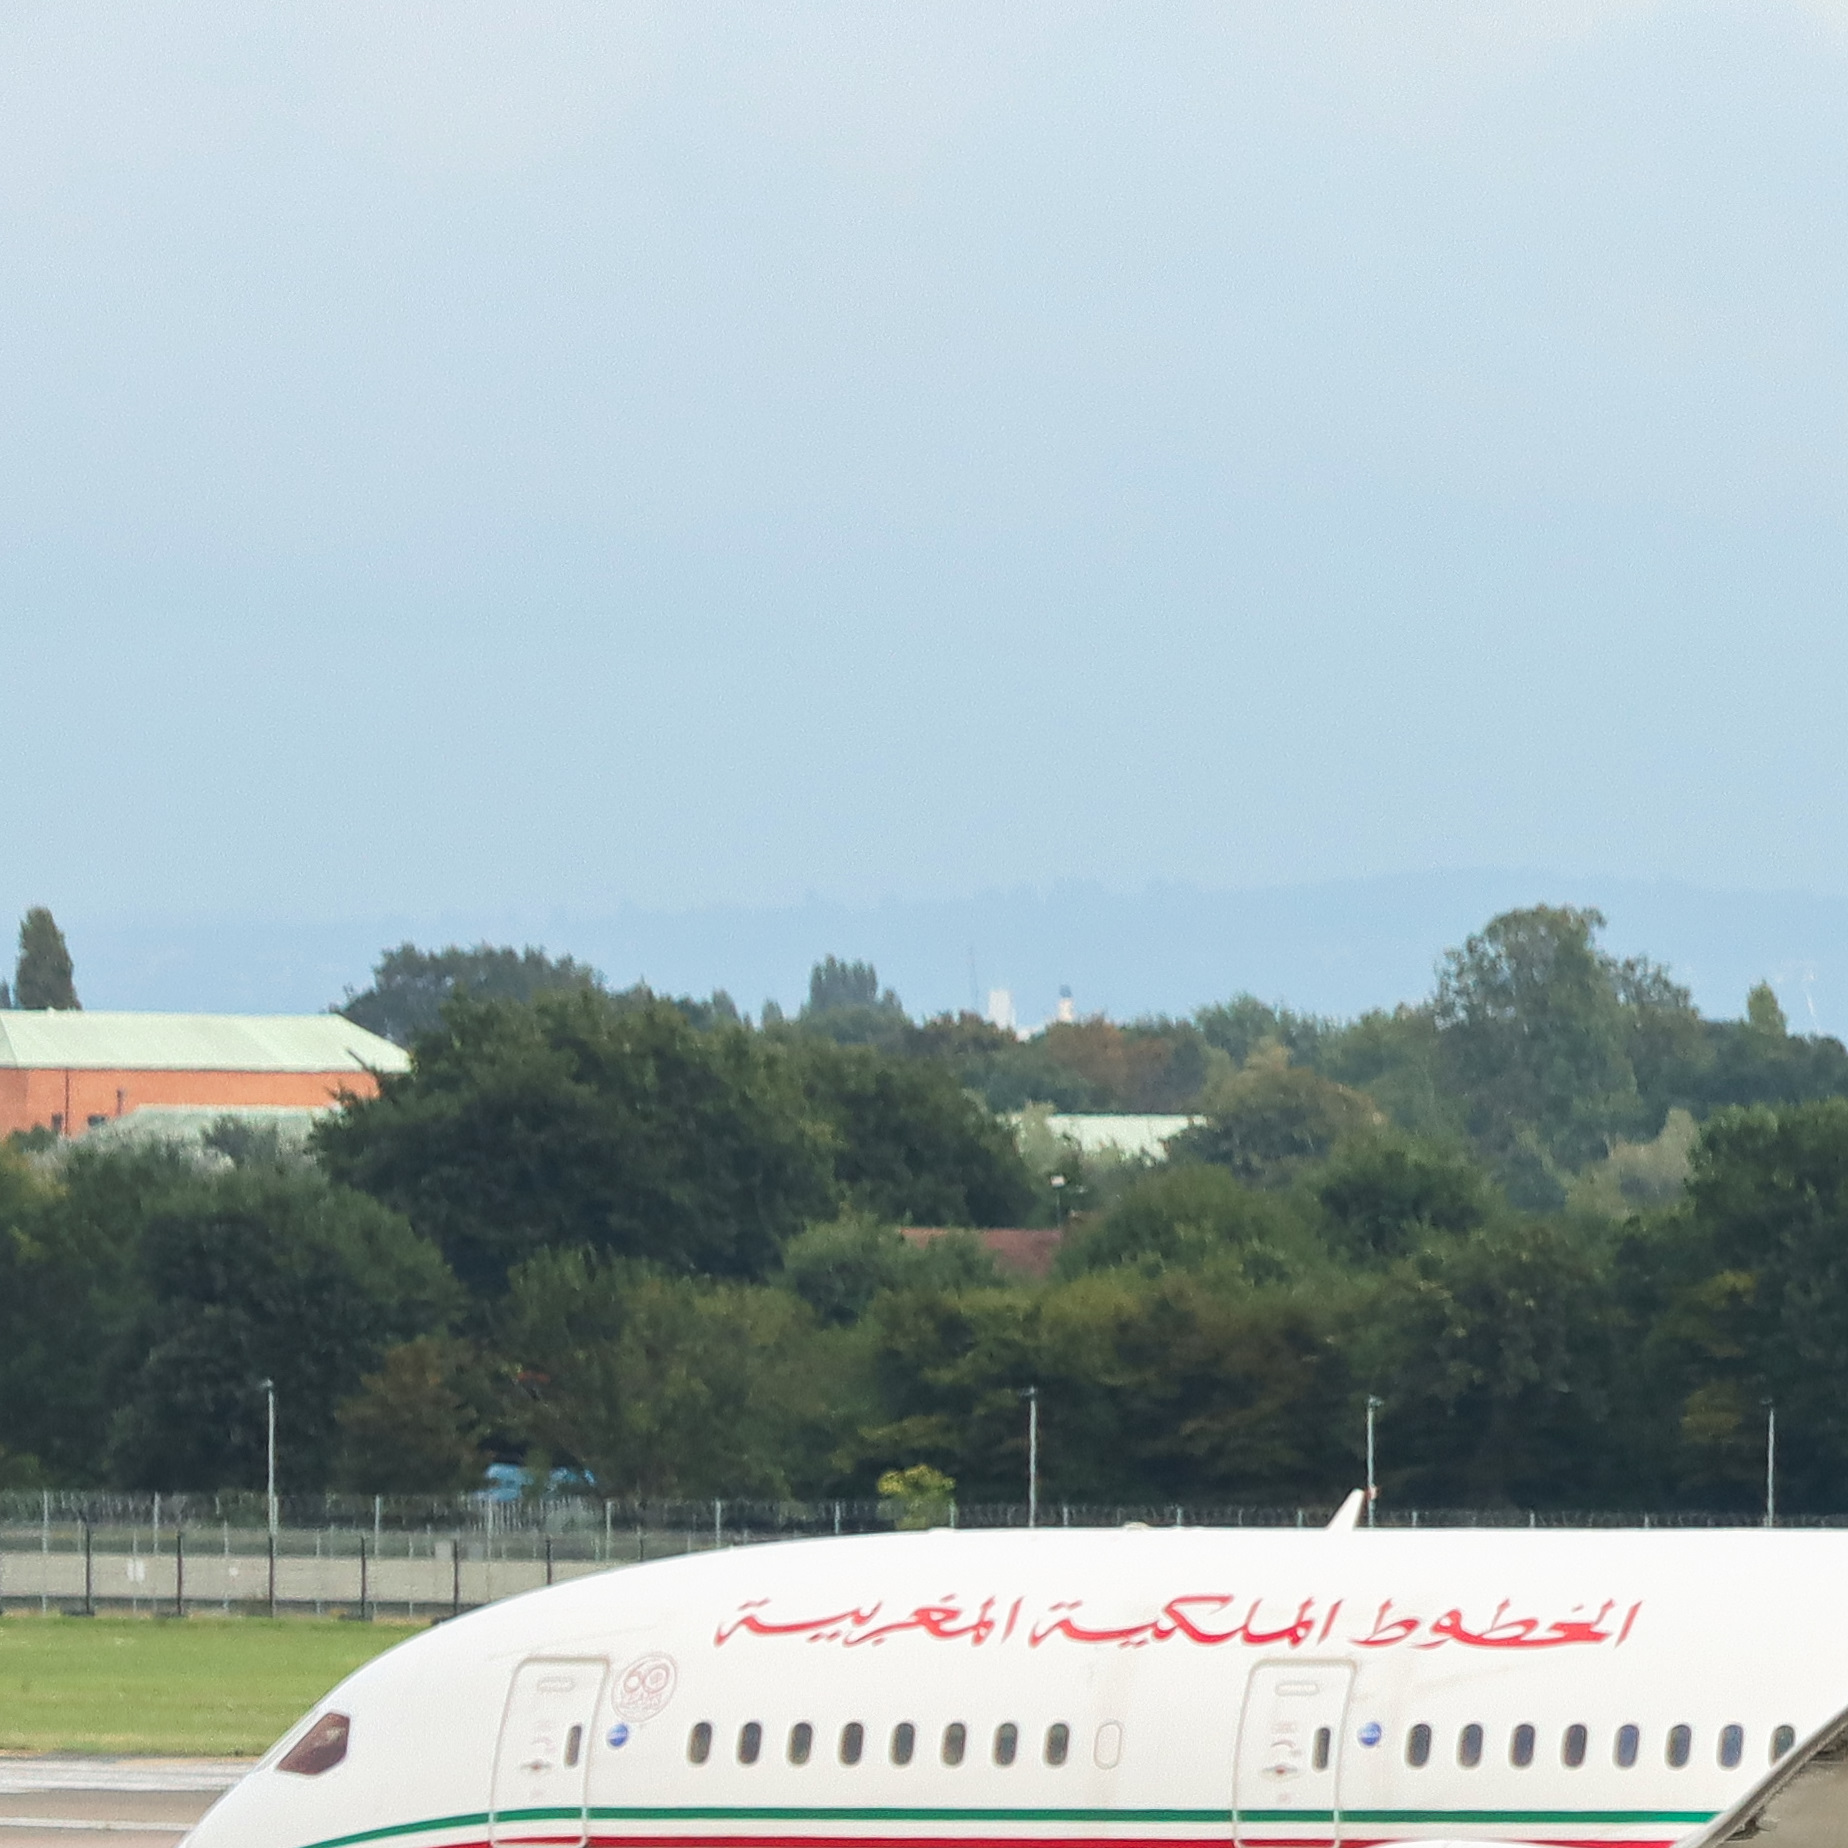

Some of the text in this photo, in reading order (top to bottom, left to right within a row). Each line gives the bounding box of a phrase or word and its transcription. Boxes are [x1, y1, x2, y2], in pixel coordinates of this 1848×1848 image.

[713, 1594, 1644, 1650] الخطوط الملكية المغربية
